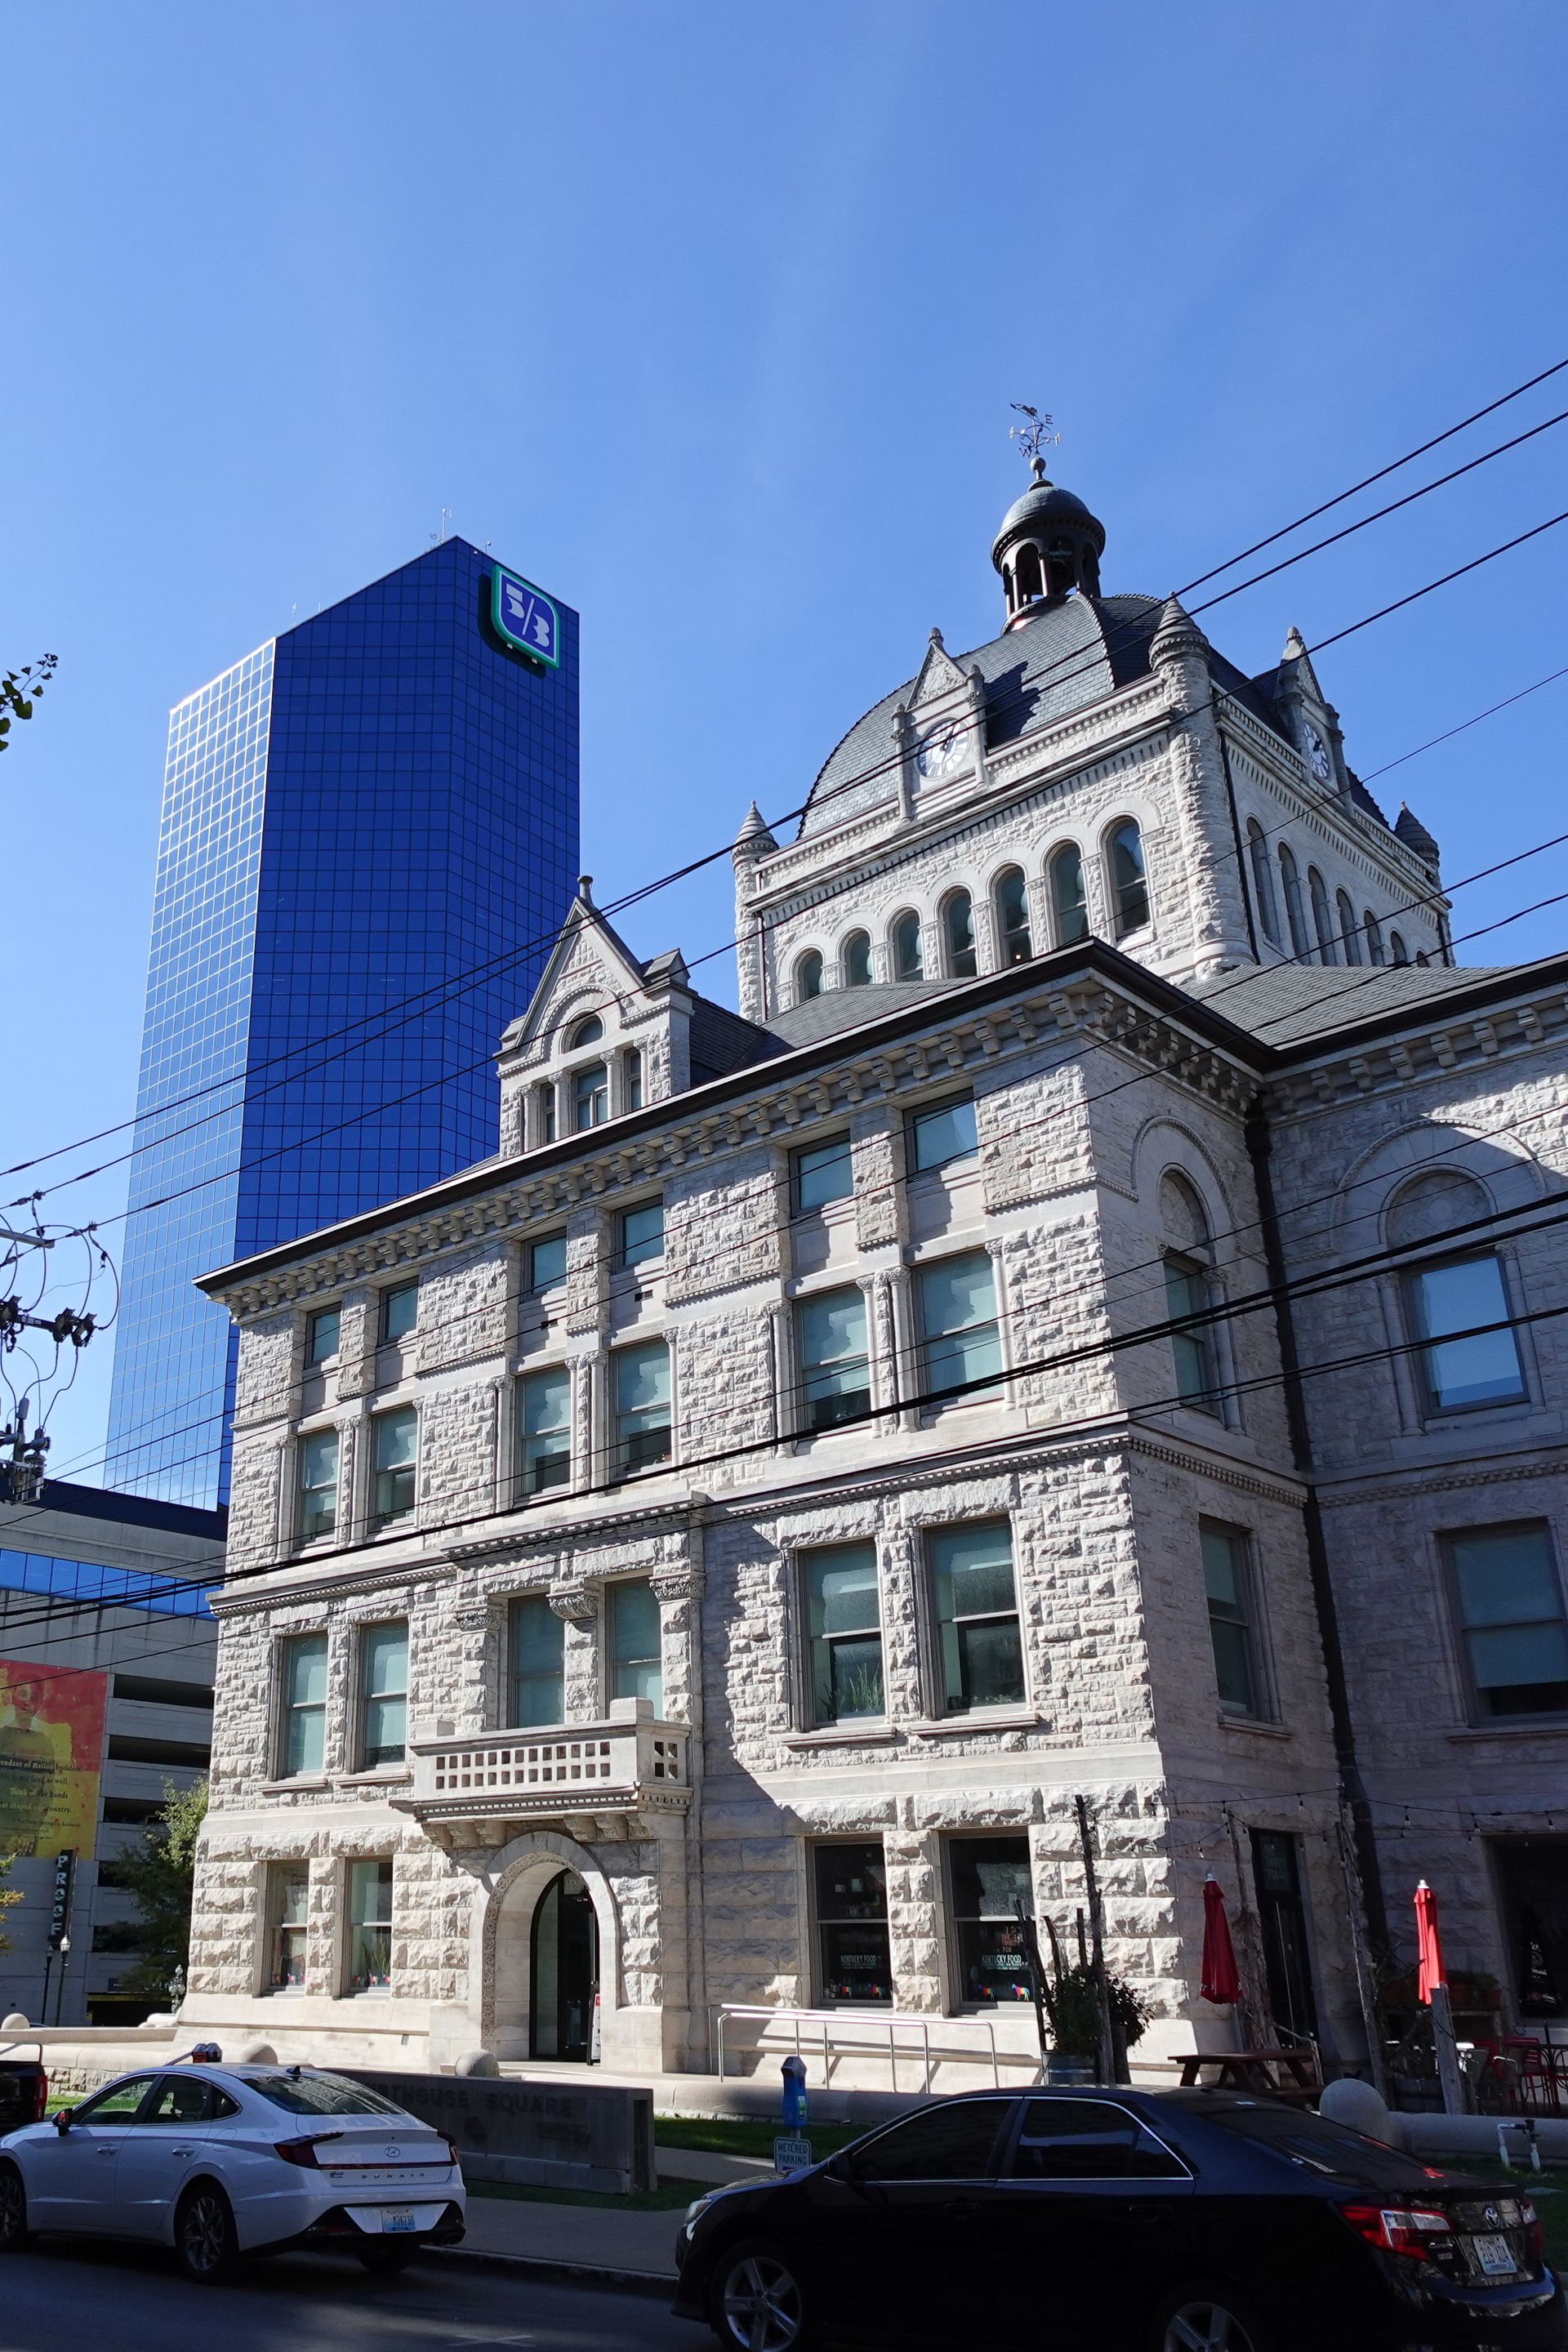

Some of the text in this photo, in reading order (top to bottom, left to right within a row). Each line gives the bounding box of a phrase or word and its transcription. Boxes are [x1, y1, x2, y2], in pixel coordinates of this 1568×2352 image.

[0, 1759, 23, 1767] endant
[9, 1787, 28, 1797] Think
[29, 1788, 37, 1797] of
[50, 1790, 68, 1799] hands
[10, 1802, 33, 1811] shaped
[51, 1855, 69, 1936] PROOF
[840, 1954, 877, 1963] KENTUCKY FOOD
[982, 1954, 1022, 1964] KENTUCKY FOOD
[485, 2091, 572, 2118] SQUARE
[777, 2142, 807, 2154] METERED
[778, 2154, 807, 2165] PARKING
